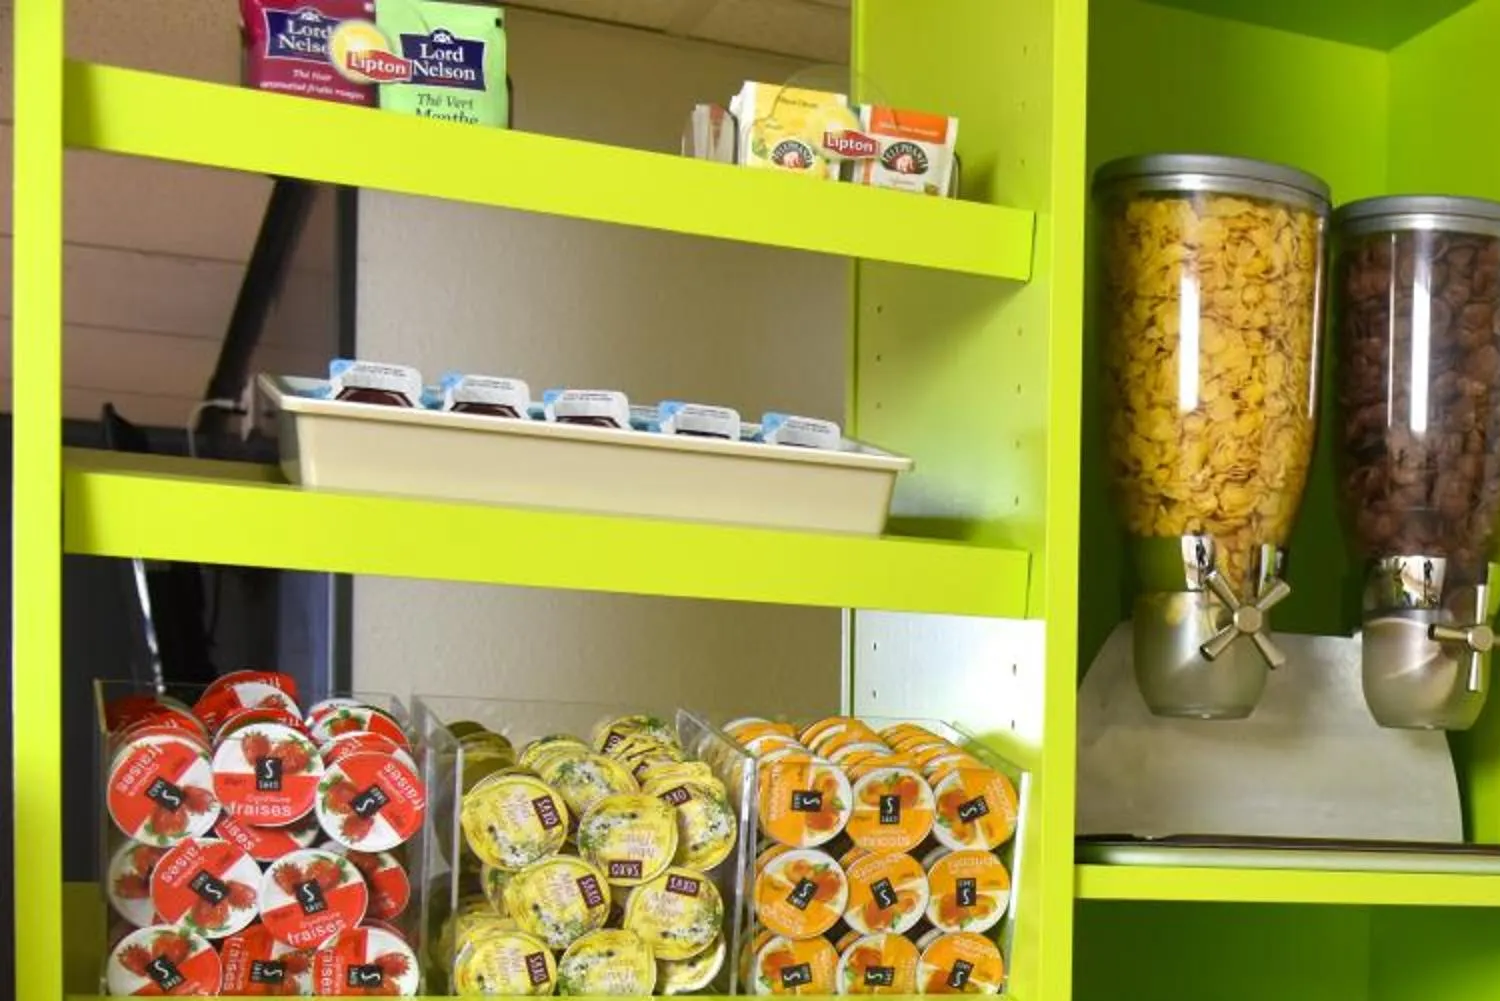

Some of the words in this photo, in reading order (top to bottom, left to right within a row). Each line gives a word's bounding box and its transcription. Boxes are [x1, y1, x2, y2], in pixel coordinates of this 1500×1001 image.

[287, 19, 332, 39] Lord
[420, 43, 464, 62] Lord
[350, 52, 406, 74] Lipton
[413, 59, 476, 81] Nelson
[828, 134, 873, 153] Lipton
[230, 799, 292, 817] fraises
